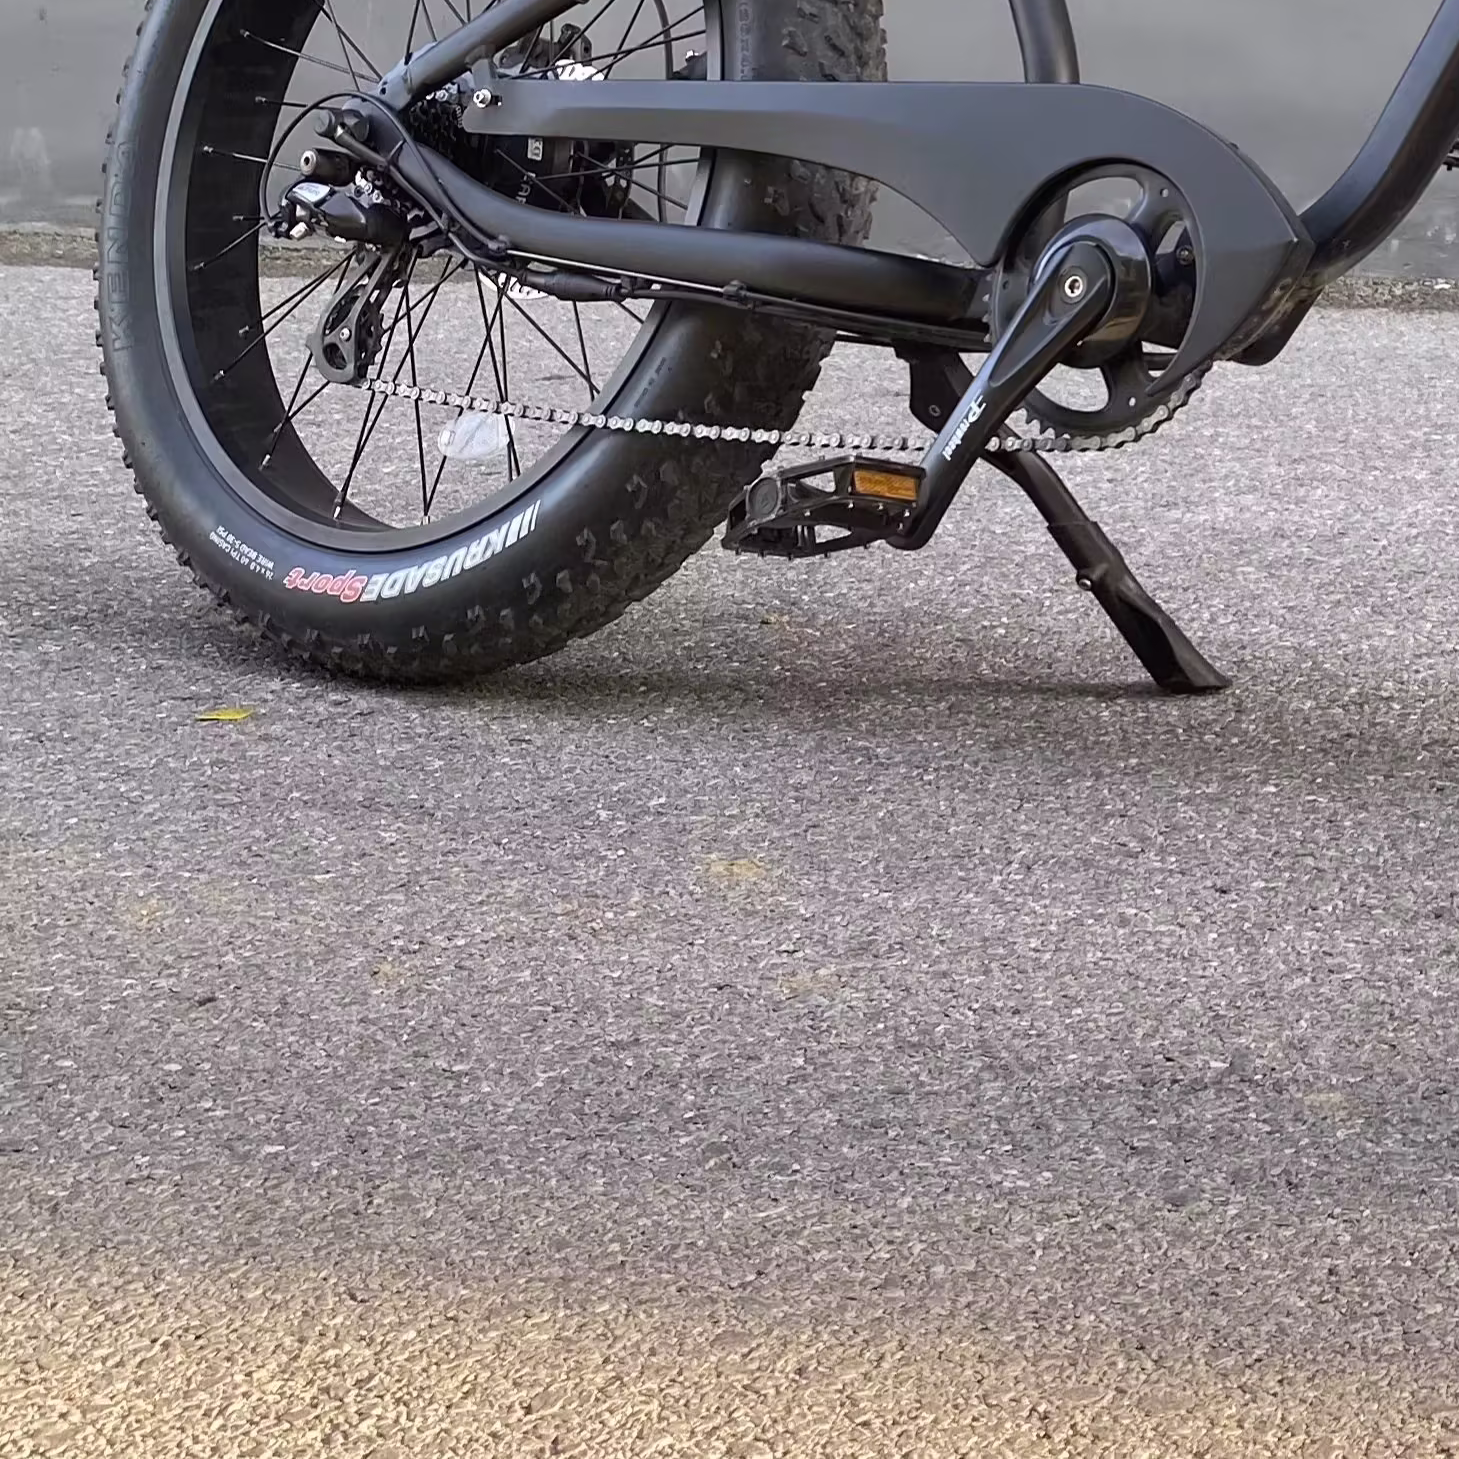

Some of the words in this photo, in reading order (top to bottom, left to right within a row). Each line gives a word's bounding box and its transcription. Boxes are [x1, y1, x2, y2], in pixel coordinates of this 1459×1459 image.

[239, 543, 258, 560] BEAD
[256, 554, 275, 570] WIRE
[360, 521, 511, 602] KRUSADE
[283, 567, 368, 603] Sport
